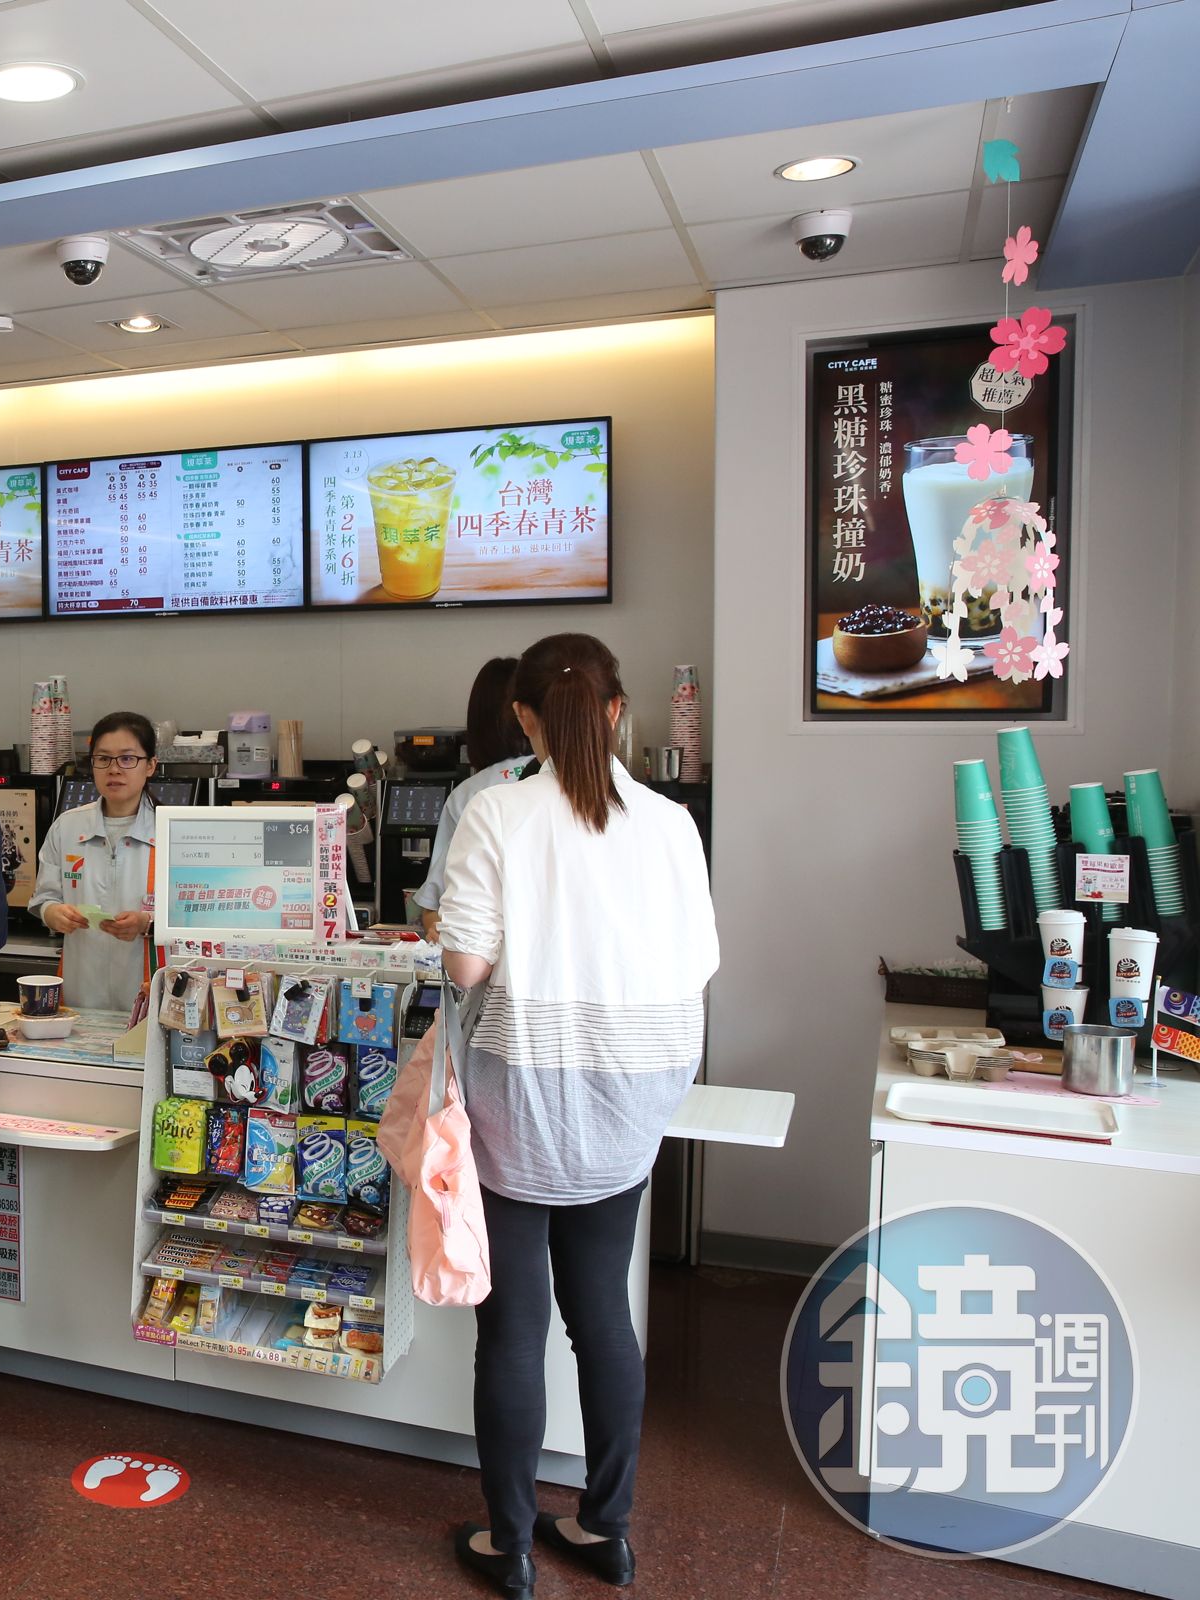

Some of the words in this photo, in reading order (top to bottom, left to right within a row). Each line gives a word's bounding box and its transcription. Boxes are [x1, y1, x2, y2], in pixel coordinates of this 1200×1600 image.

[828, 360, 850, 369] CITY
[852, 358, 878, 367] CAFE
[832, 383, 869, 583] 黑糖珍珠撞奶
[498, 479, 553, 507] 台灣
[323, 476, 337, 575] 四季春青茶系列
[456, 506, 597, 538] 四季春青茶
[171, 594, 258, 608] 提供自備飲料杯優惠
[289, 824, 310, 834] $64
[172, 1234, 204, 1244] mentos
[161, 1250, 194, 1258] mentos
[164, 1245, 197, 1253] mentos
[159, 1255, 191, 1265] mentos
